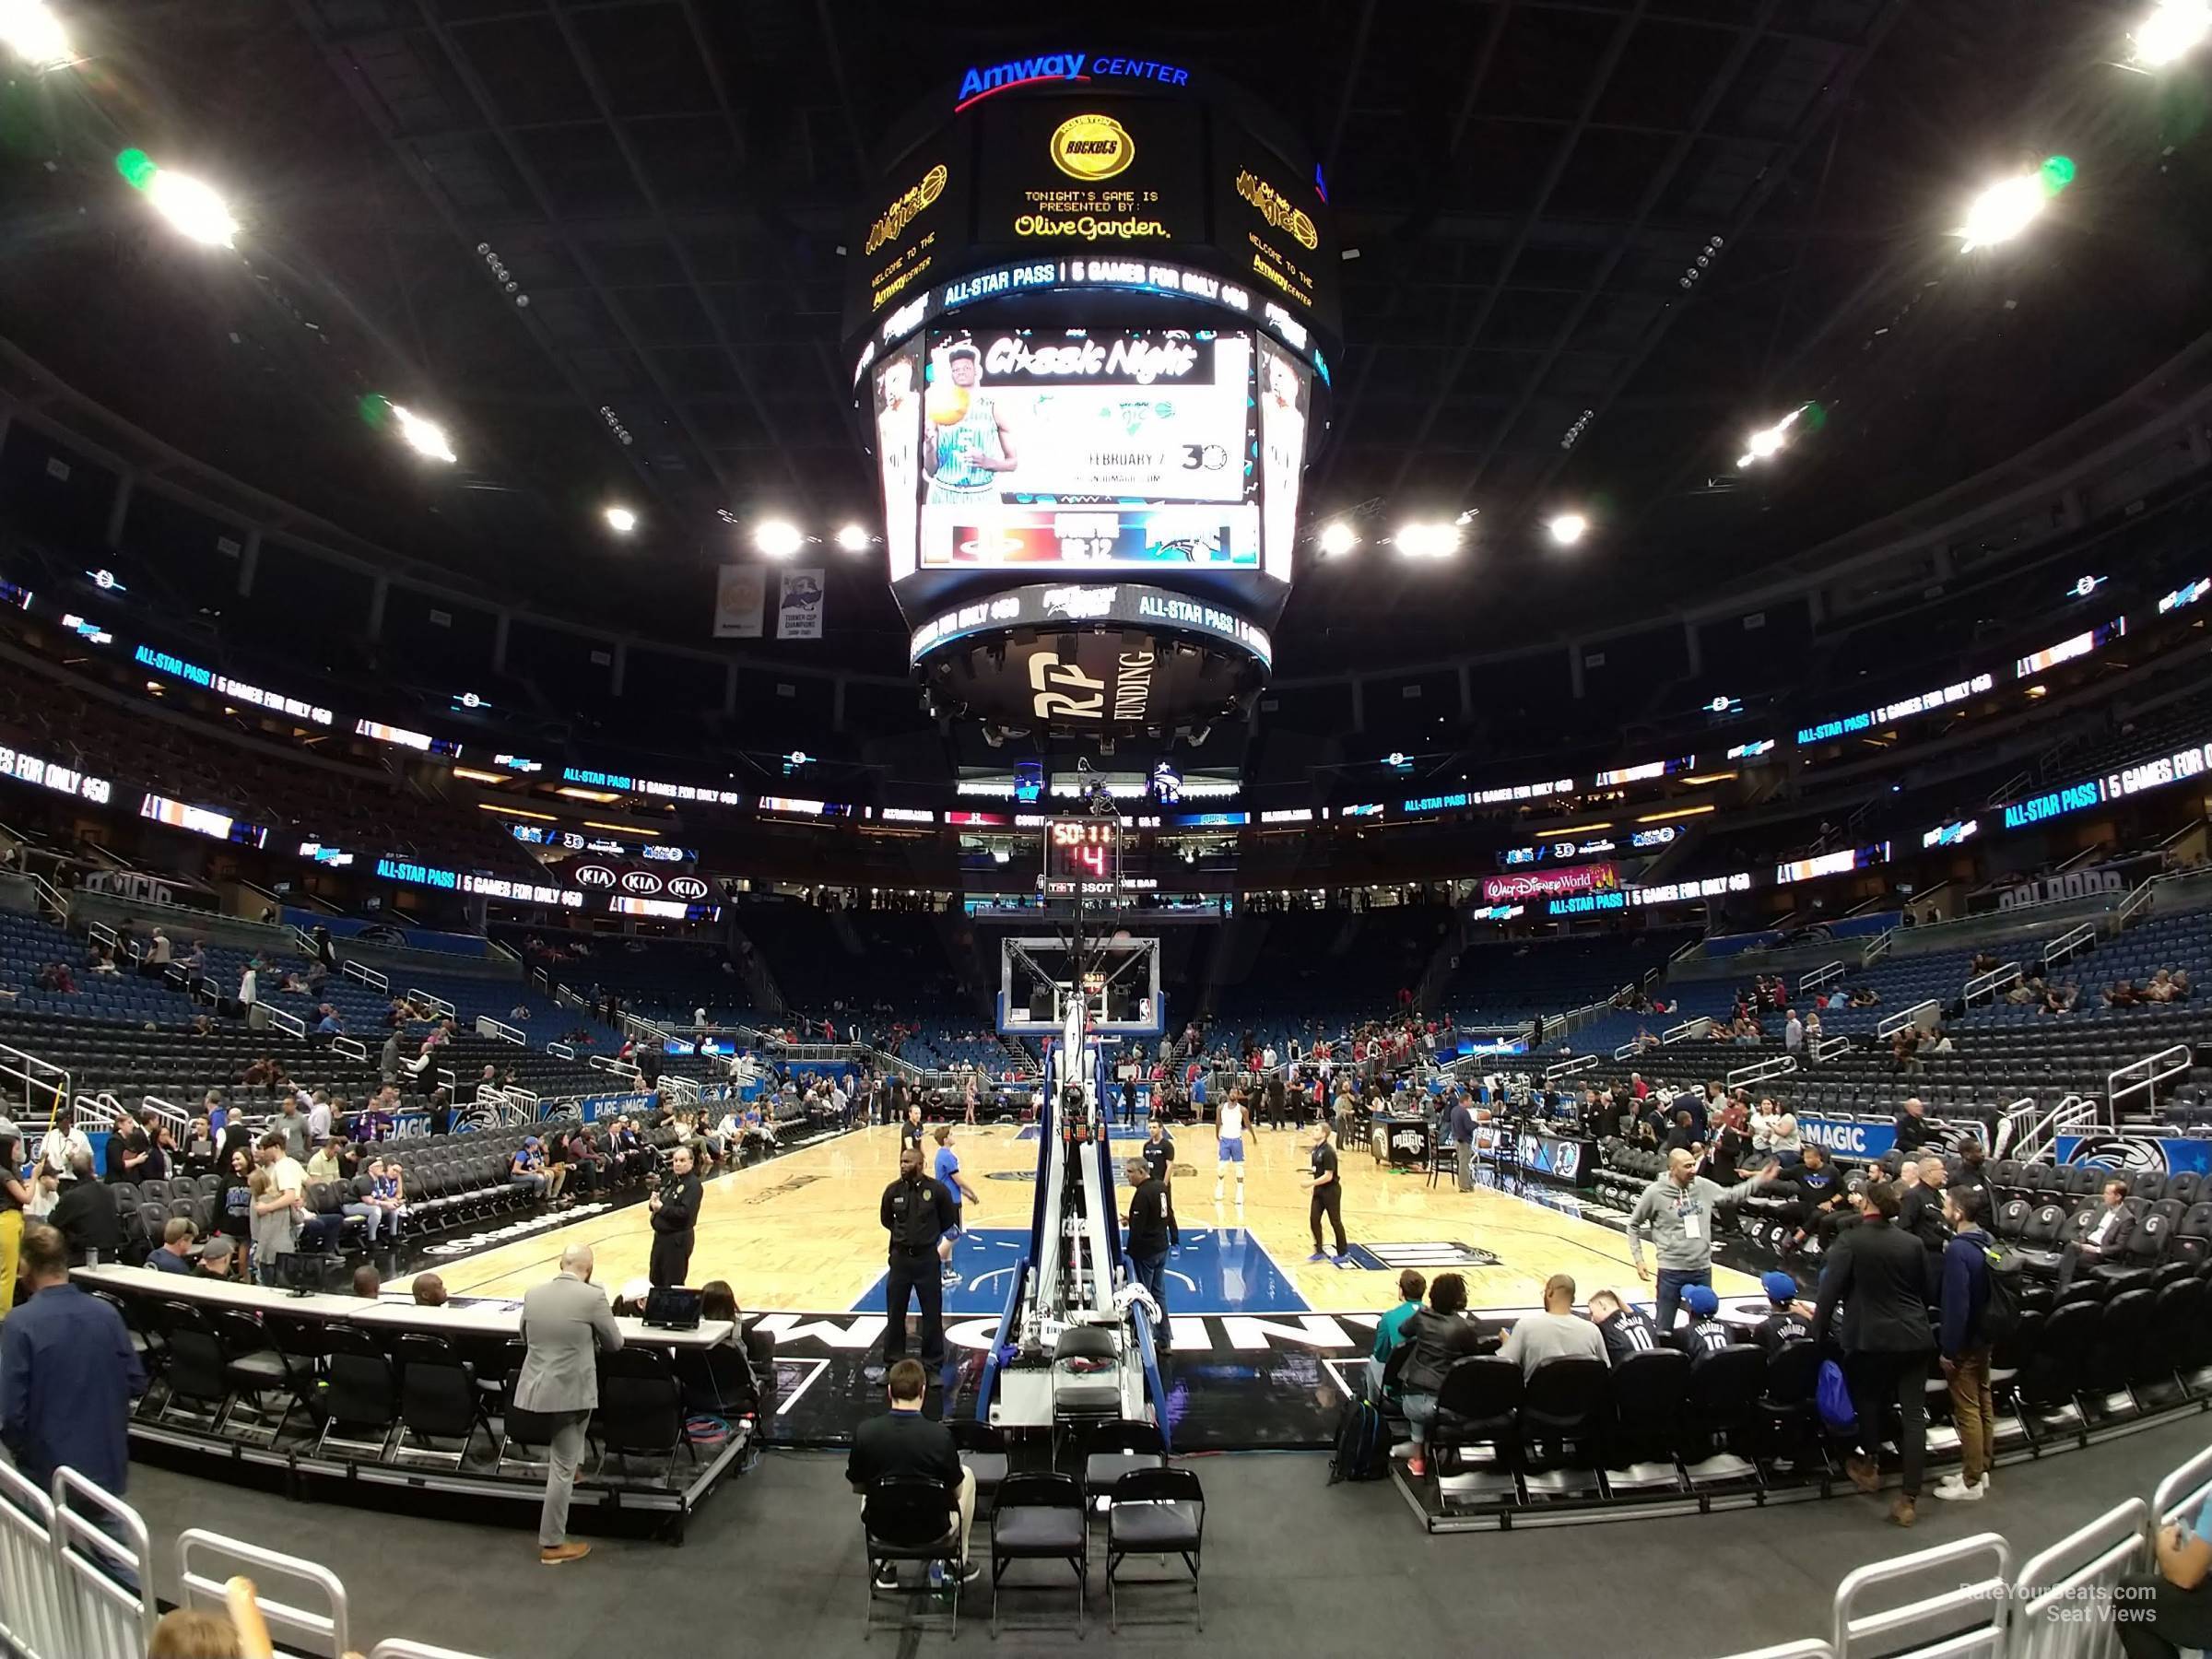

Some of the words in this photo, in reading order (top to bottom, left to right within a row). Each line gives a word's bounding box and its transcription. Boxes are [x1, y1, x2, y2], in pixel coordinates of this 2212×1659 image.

[959, 53, 1085, 100] Amway
[1093, 58, 1188, 86] CENTER
[1025, 192, 1096, 201] TONIGHT'S
[1102, 192, 1135, 201] GAME
[1143, 192, 1159, 201] IS
[1040, 202, 1112, 212] PRESENTED
[1118, 202, 1140, 212] BY:
[872, 256, 903, 288] WELCOME
[907, 246, 917, 260] TO
[921, 231, 935, 249] THE
[1249, 232, 1282, 265] WELCOME
[1286, 261, 1296, 275] TO
[1300, 271, 1313, 288] THE
[874, 273, 908, 309] Amway
[905, 256, 932, 282] CENTER
[945, 271, 1009, 306] ALL-STAR
[1013, 264, 1055, 287] PASS
[1253, 254, 1288, 291] Amway
[1288, 284, 1312, 308] CENTER
[1140, 596, 1202, 624] ALL-STAR
[1206, 608, 1233, 634] PASS
[135, 645, 182, 677] ALL-STAR
[183, 663, 210, 686] PASS
[1114, 650, 1154, 721] FUNDING
[1798, 722, 1843, 744] ALL-STAR
[1844, 713, 1869, 733] PASS
[16, 754, 45, 783] FOR
[45, 764, 81, 794] ONLY
[563, 768, 605, 785] ALL-STAR
[606, 774, 630, 790] PASS
[2005, 793, 2060, 828] ALL-STAR
[2061, 782, 2098, 812] PASS
[2108, 774, 2121, 798] 5
[2122, 759, 2173, 794] GAMES
[2173, 747, 2205, 778] FOR
[1405, 798, 1442, 811] ALL-STAR
[1444, 794, 1465, 806] PASS
[377, 859, 427, 883] ALL-STAR
[428, 868, 454, 888] PASS
[512, 883, 533, 900] FOR
[582, 869, 609, 886] KIA
[629, 877, 656, 891] KIA
[675, 882, 700, 898] KIA
[1069, 882, 1113, 893] TSSOT
[1560, 873, 1591, 888] World
[1549, 895, 1594, 914] ALL-STAR
[1596, 892, 1623, 909] PASS
[594, 1100, 618, 1118] PURE
[1393, 1133, 1425, 1148] MAGIC
[1806, 1124, 1866, 1153] MAGIC
[1625, 1325, 1654, 1352] 10
